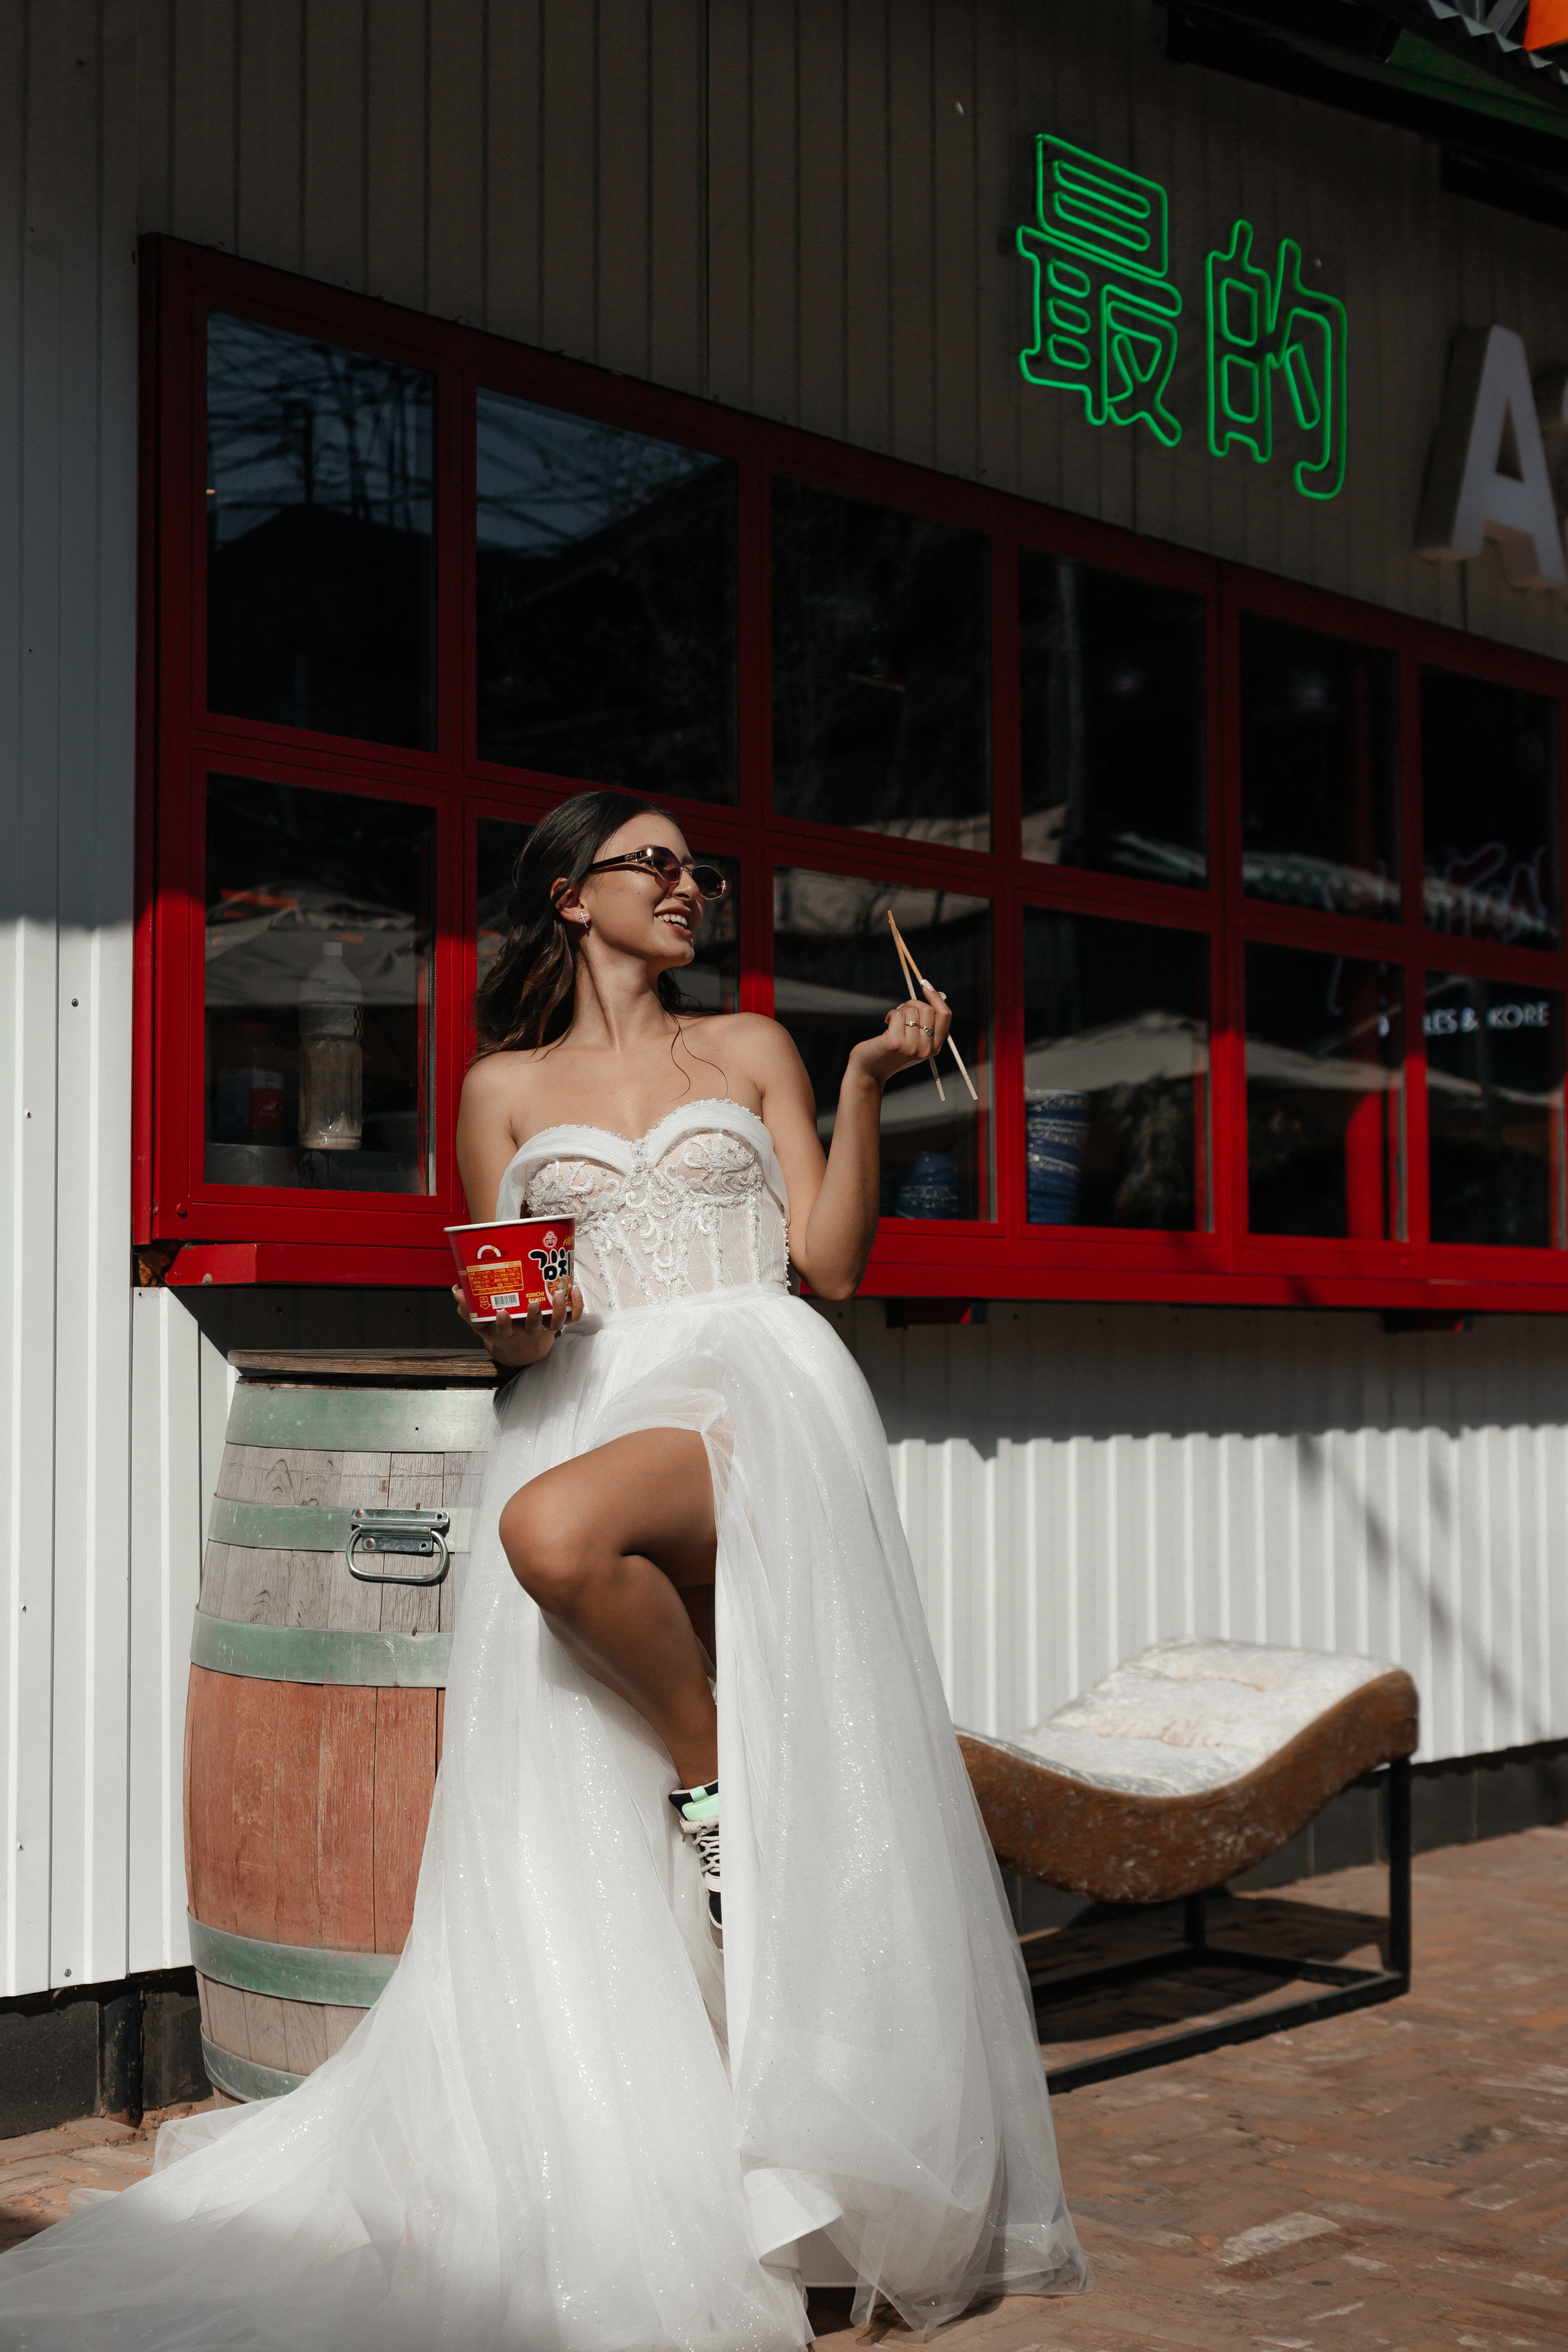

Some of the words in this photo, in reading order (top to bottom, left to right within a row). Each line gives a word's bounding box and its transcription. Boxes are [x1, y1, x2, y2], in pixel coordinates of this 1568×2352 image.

[1017, 133, 1348, 500] 最的
[1451, 323, 1568, 583] A
[529, 1248, 574, 1281] 김치
